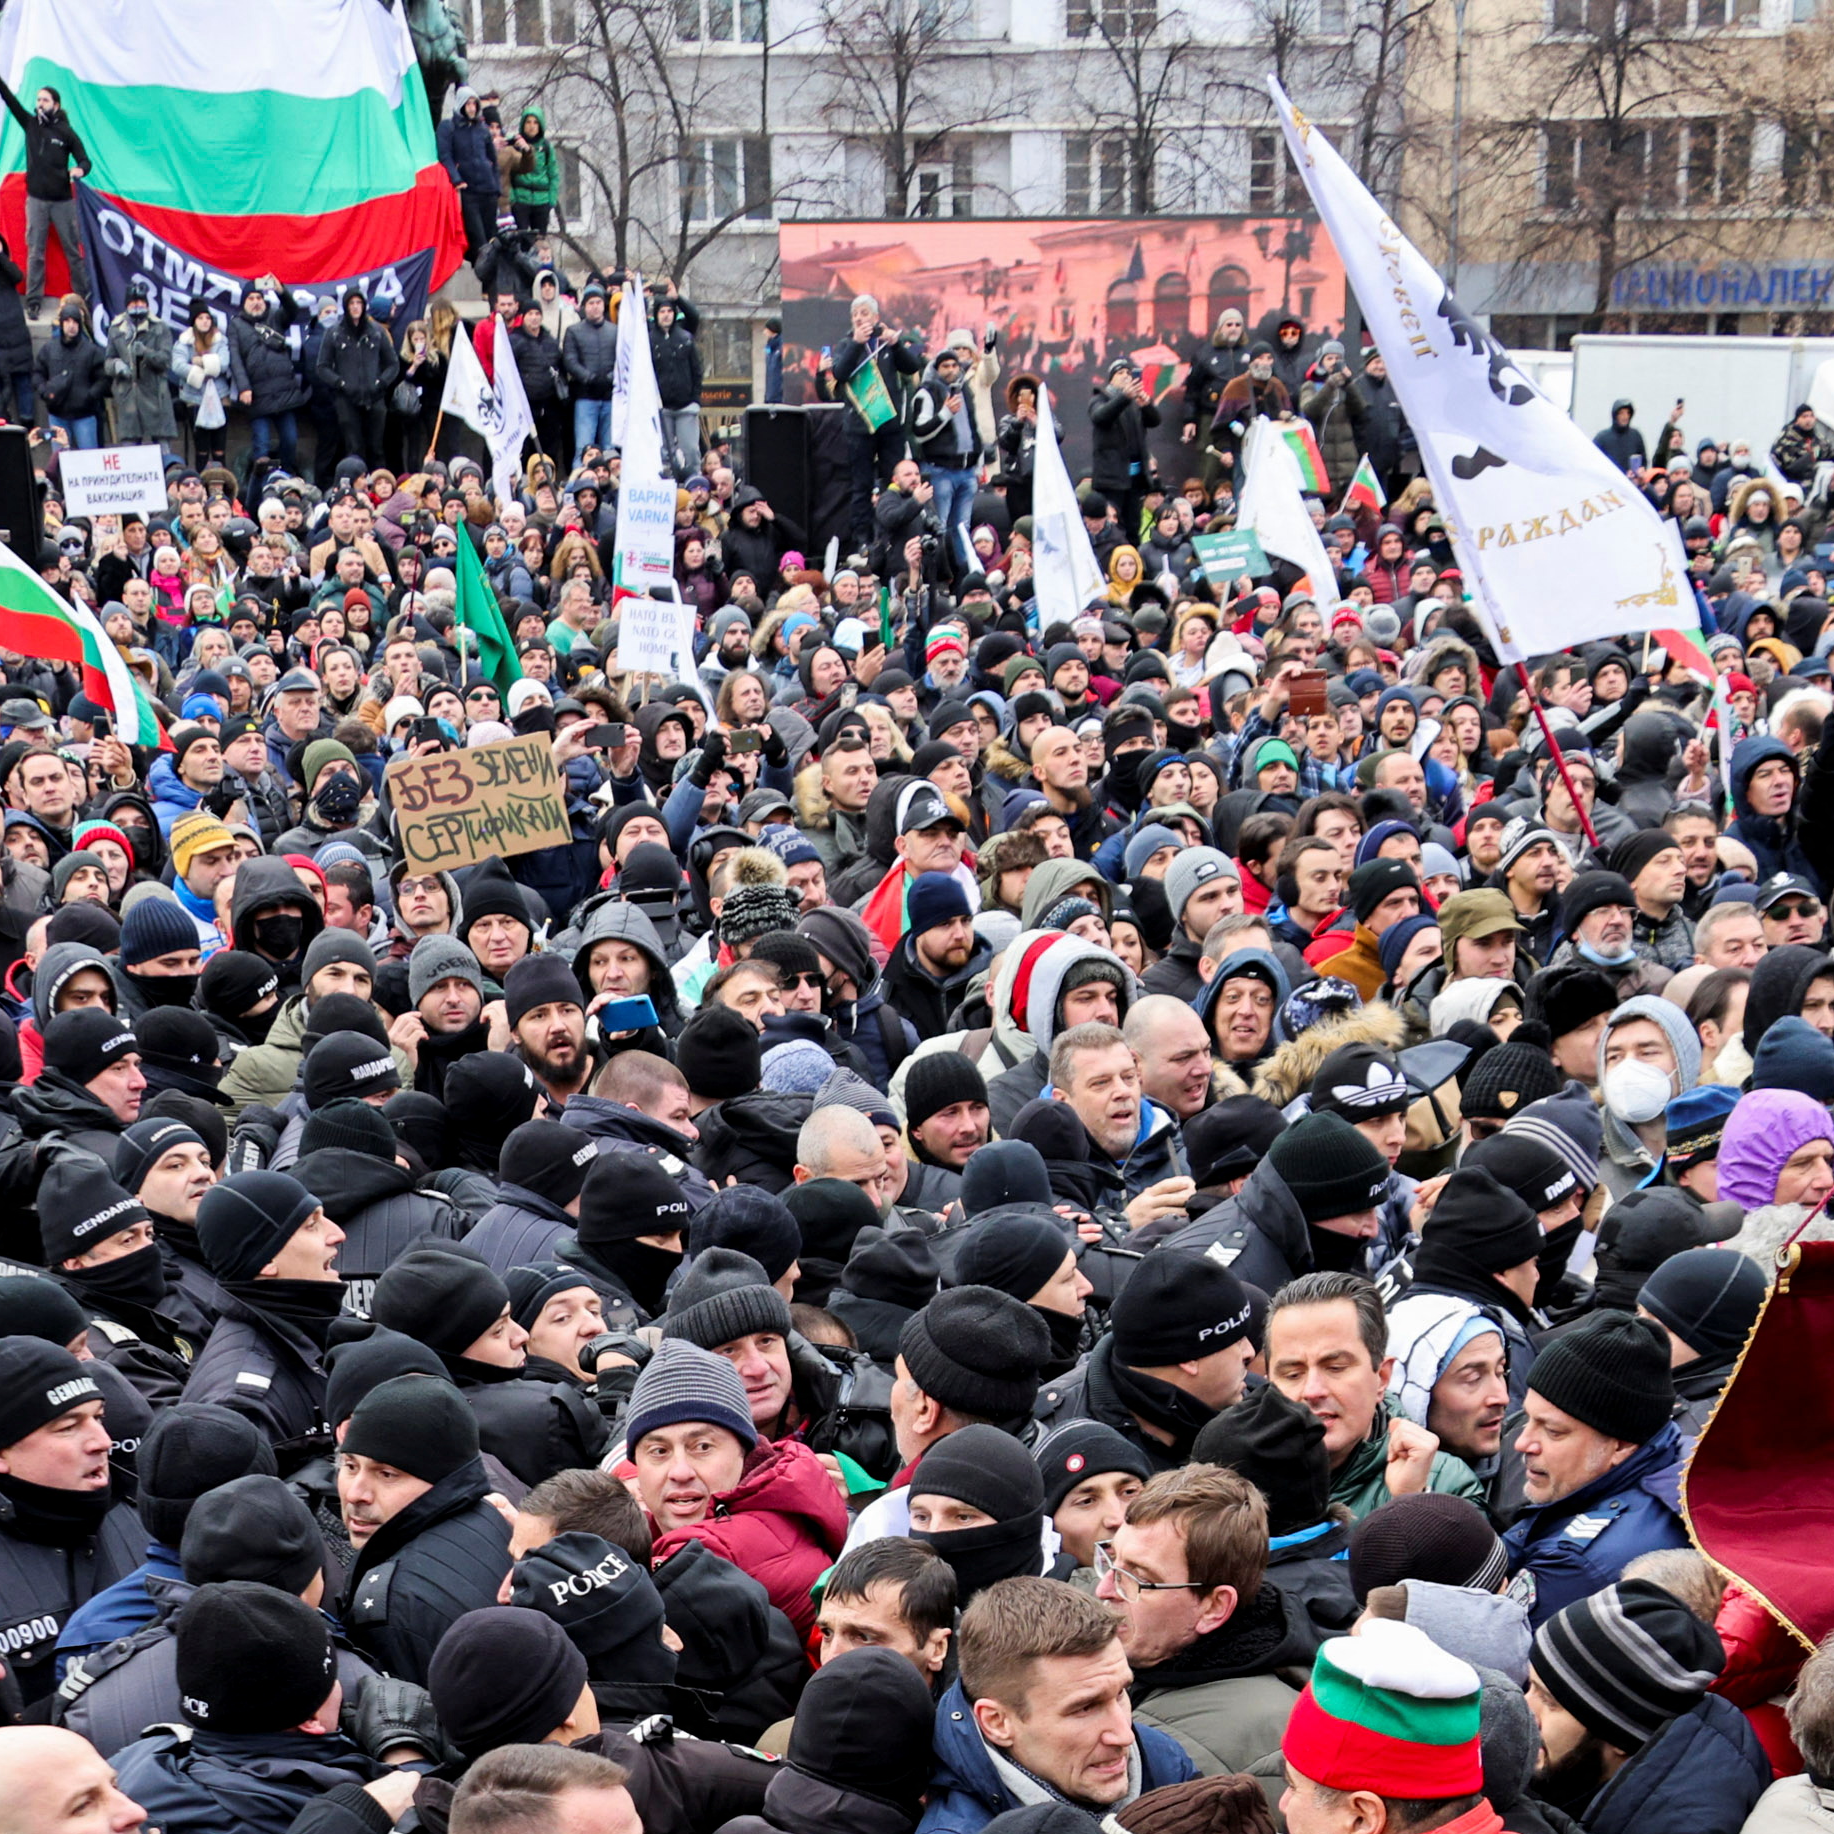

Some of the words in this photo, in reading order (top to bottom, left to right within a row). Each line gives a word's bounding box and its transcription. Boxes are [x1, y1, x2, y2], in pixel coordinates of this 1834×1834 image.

[102, 454, 122, 471] НЕ
[628, 487, 671, 505] ВАРНА
[627, 507, 670, 524] VARNA
[387, 760, 470, 813] БЕЗ
[468, 743, 555, 788] ЗЕЛЕНИ
